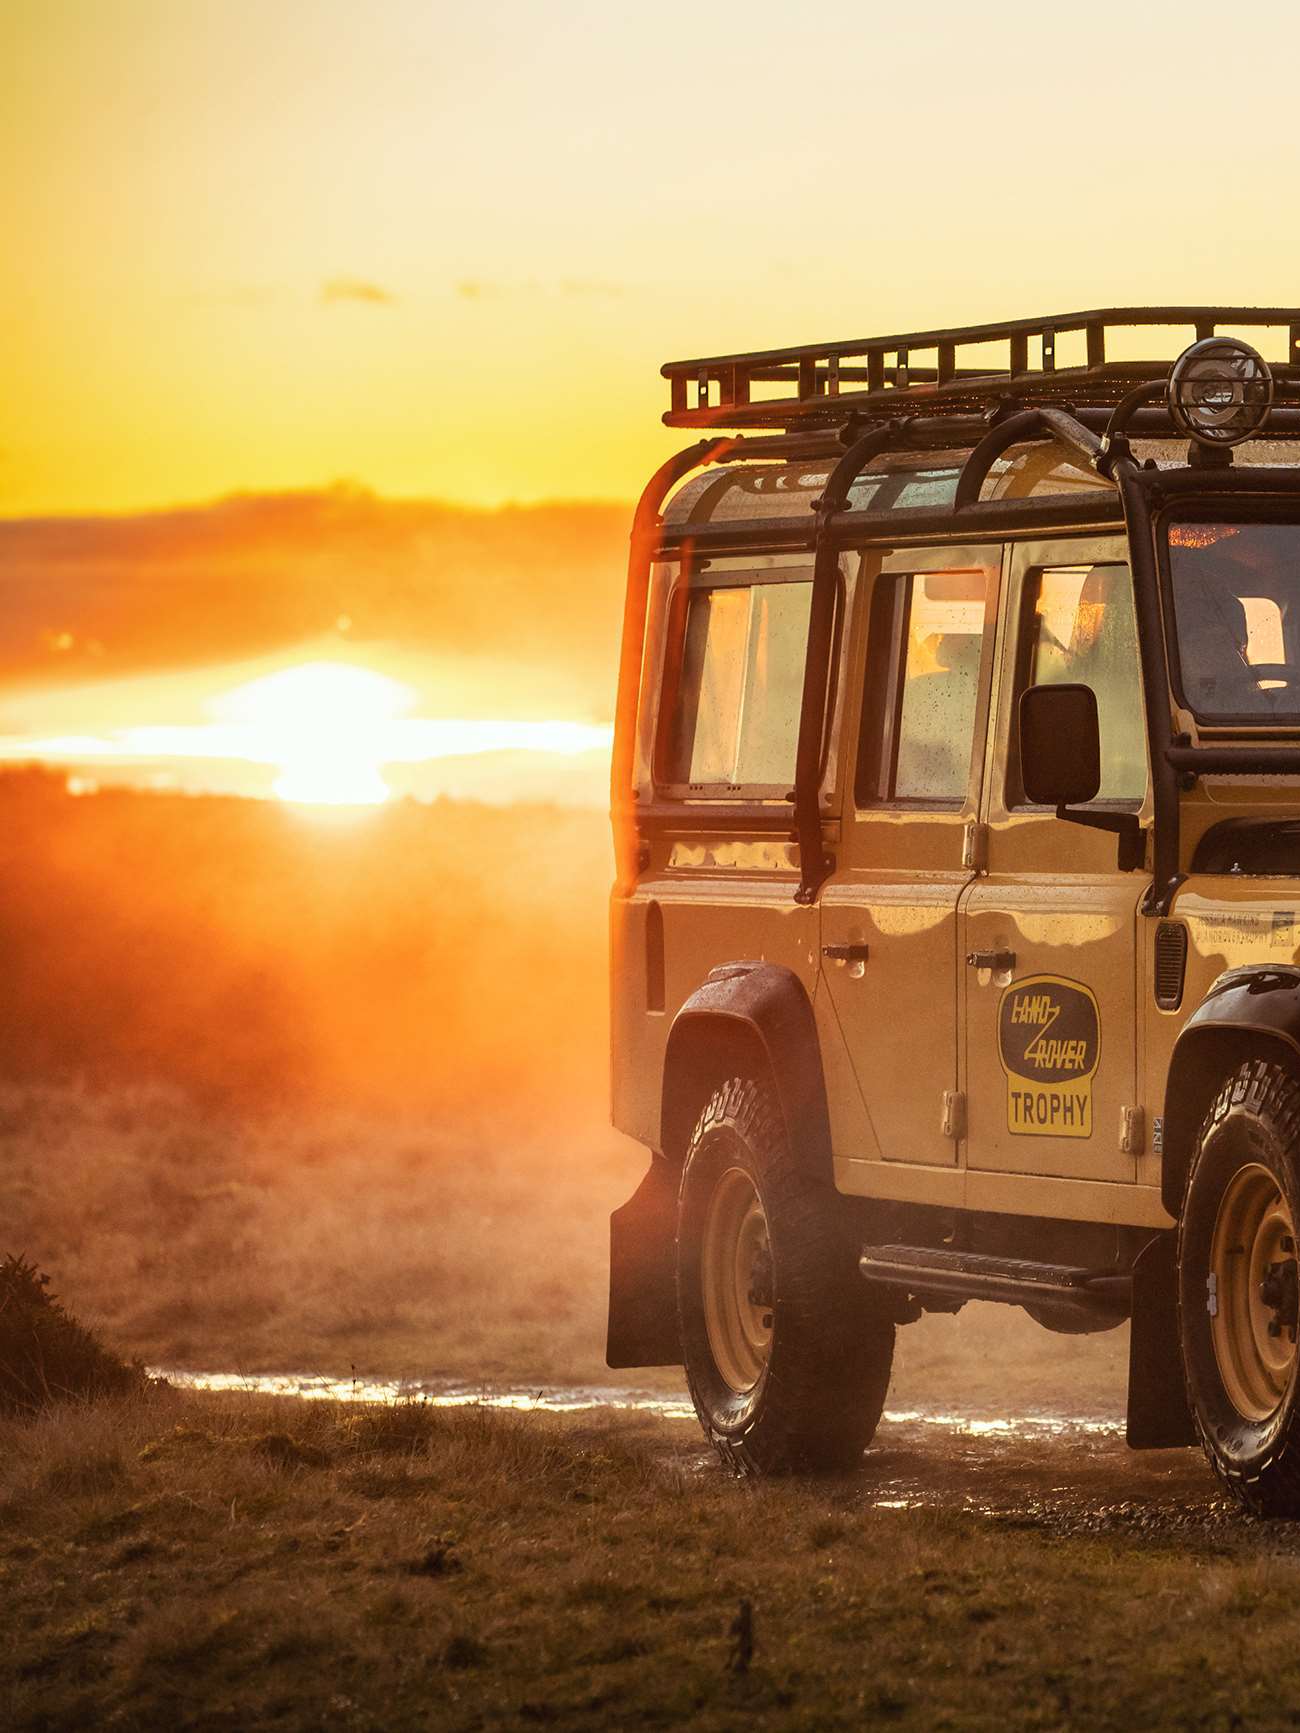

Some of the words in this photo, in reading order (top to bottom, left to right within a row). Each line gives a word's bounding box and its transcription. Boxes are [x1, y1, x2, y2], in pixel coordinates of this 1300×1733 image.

[1011, 995, 1051, 1025] LAND
[1035, 1040, 1087, 1070] ROVER
[1011, 1091, 1088, 1127] TROPHY
